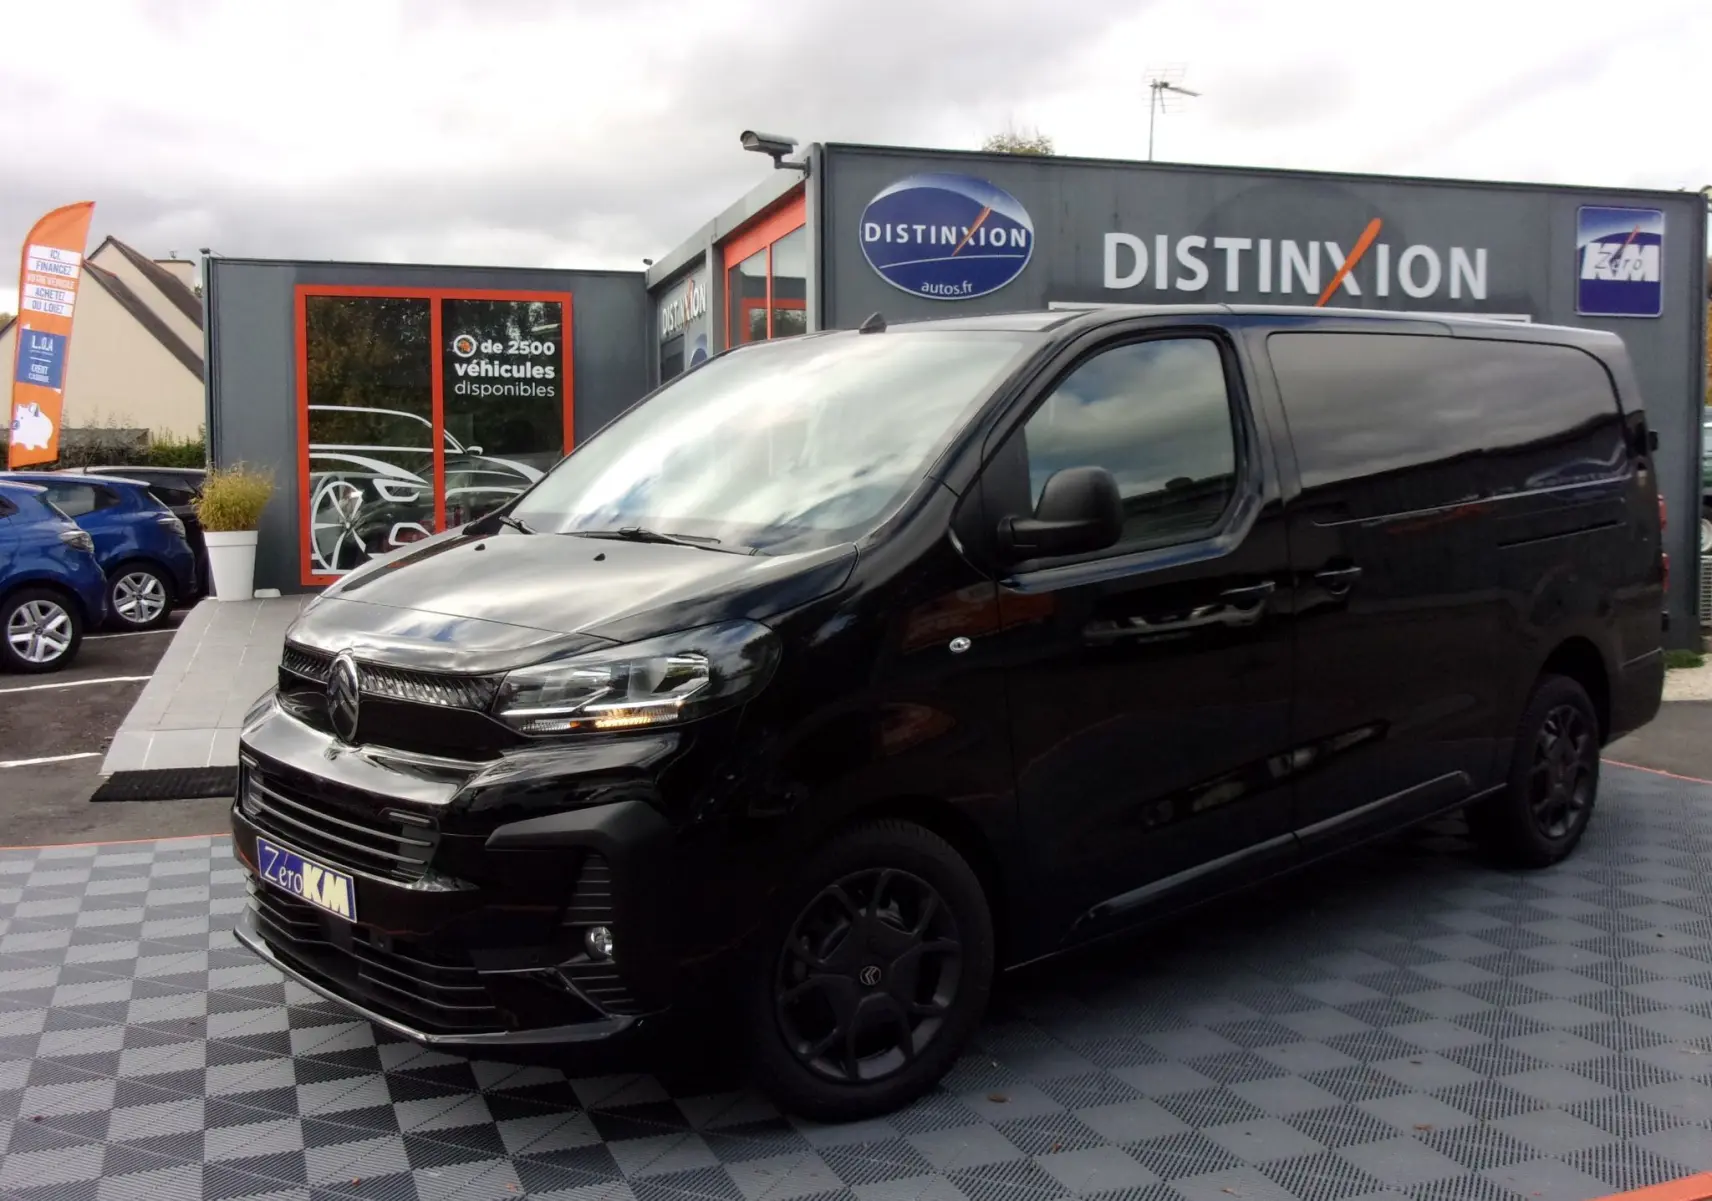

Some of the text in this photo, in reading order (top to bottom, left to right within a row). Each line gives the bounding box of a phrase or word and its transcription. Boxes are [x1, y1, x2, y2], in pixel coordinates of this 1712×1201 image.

[864, 210, 1026, 253] DISTINXION
[1104, 218, 1487, 306] DISTINXION
[921, 280, 973, 295] autos.fr
[480, 339, 556, 355] de 2500
[453, 359, 556, 379] véhicules
[454, 380, 555, 398] disponibles
